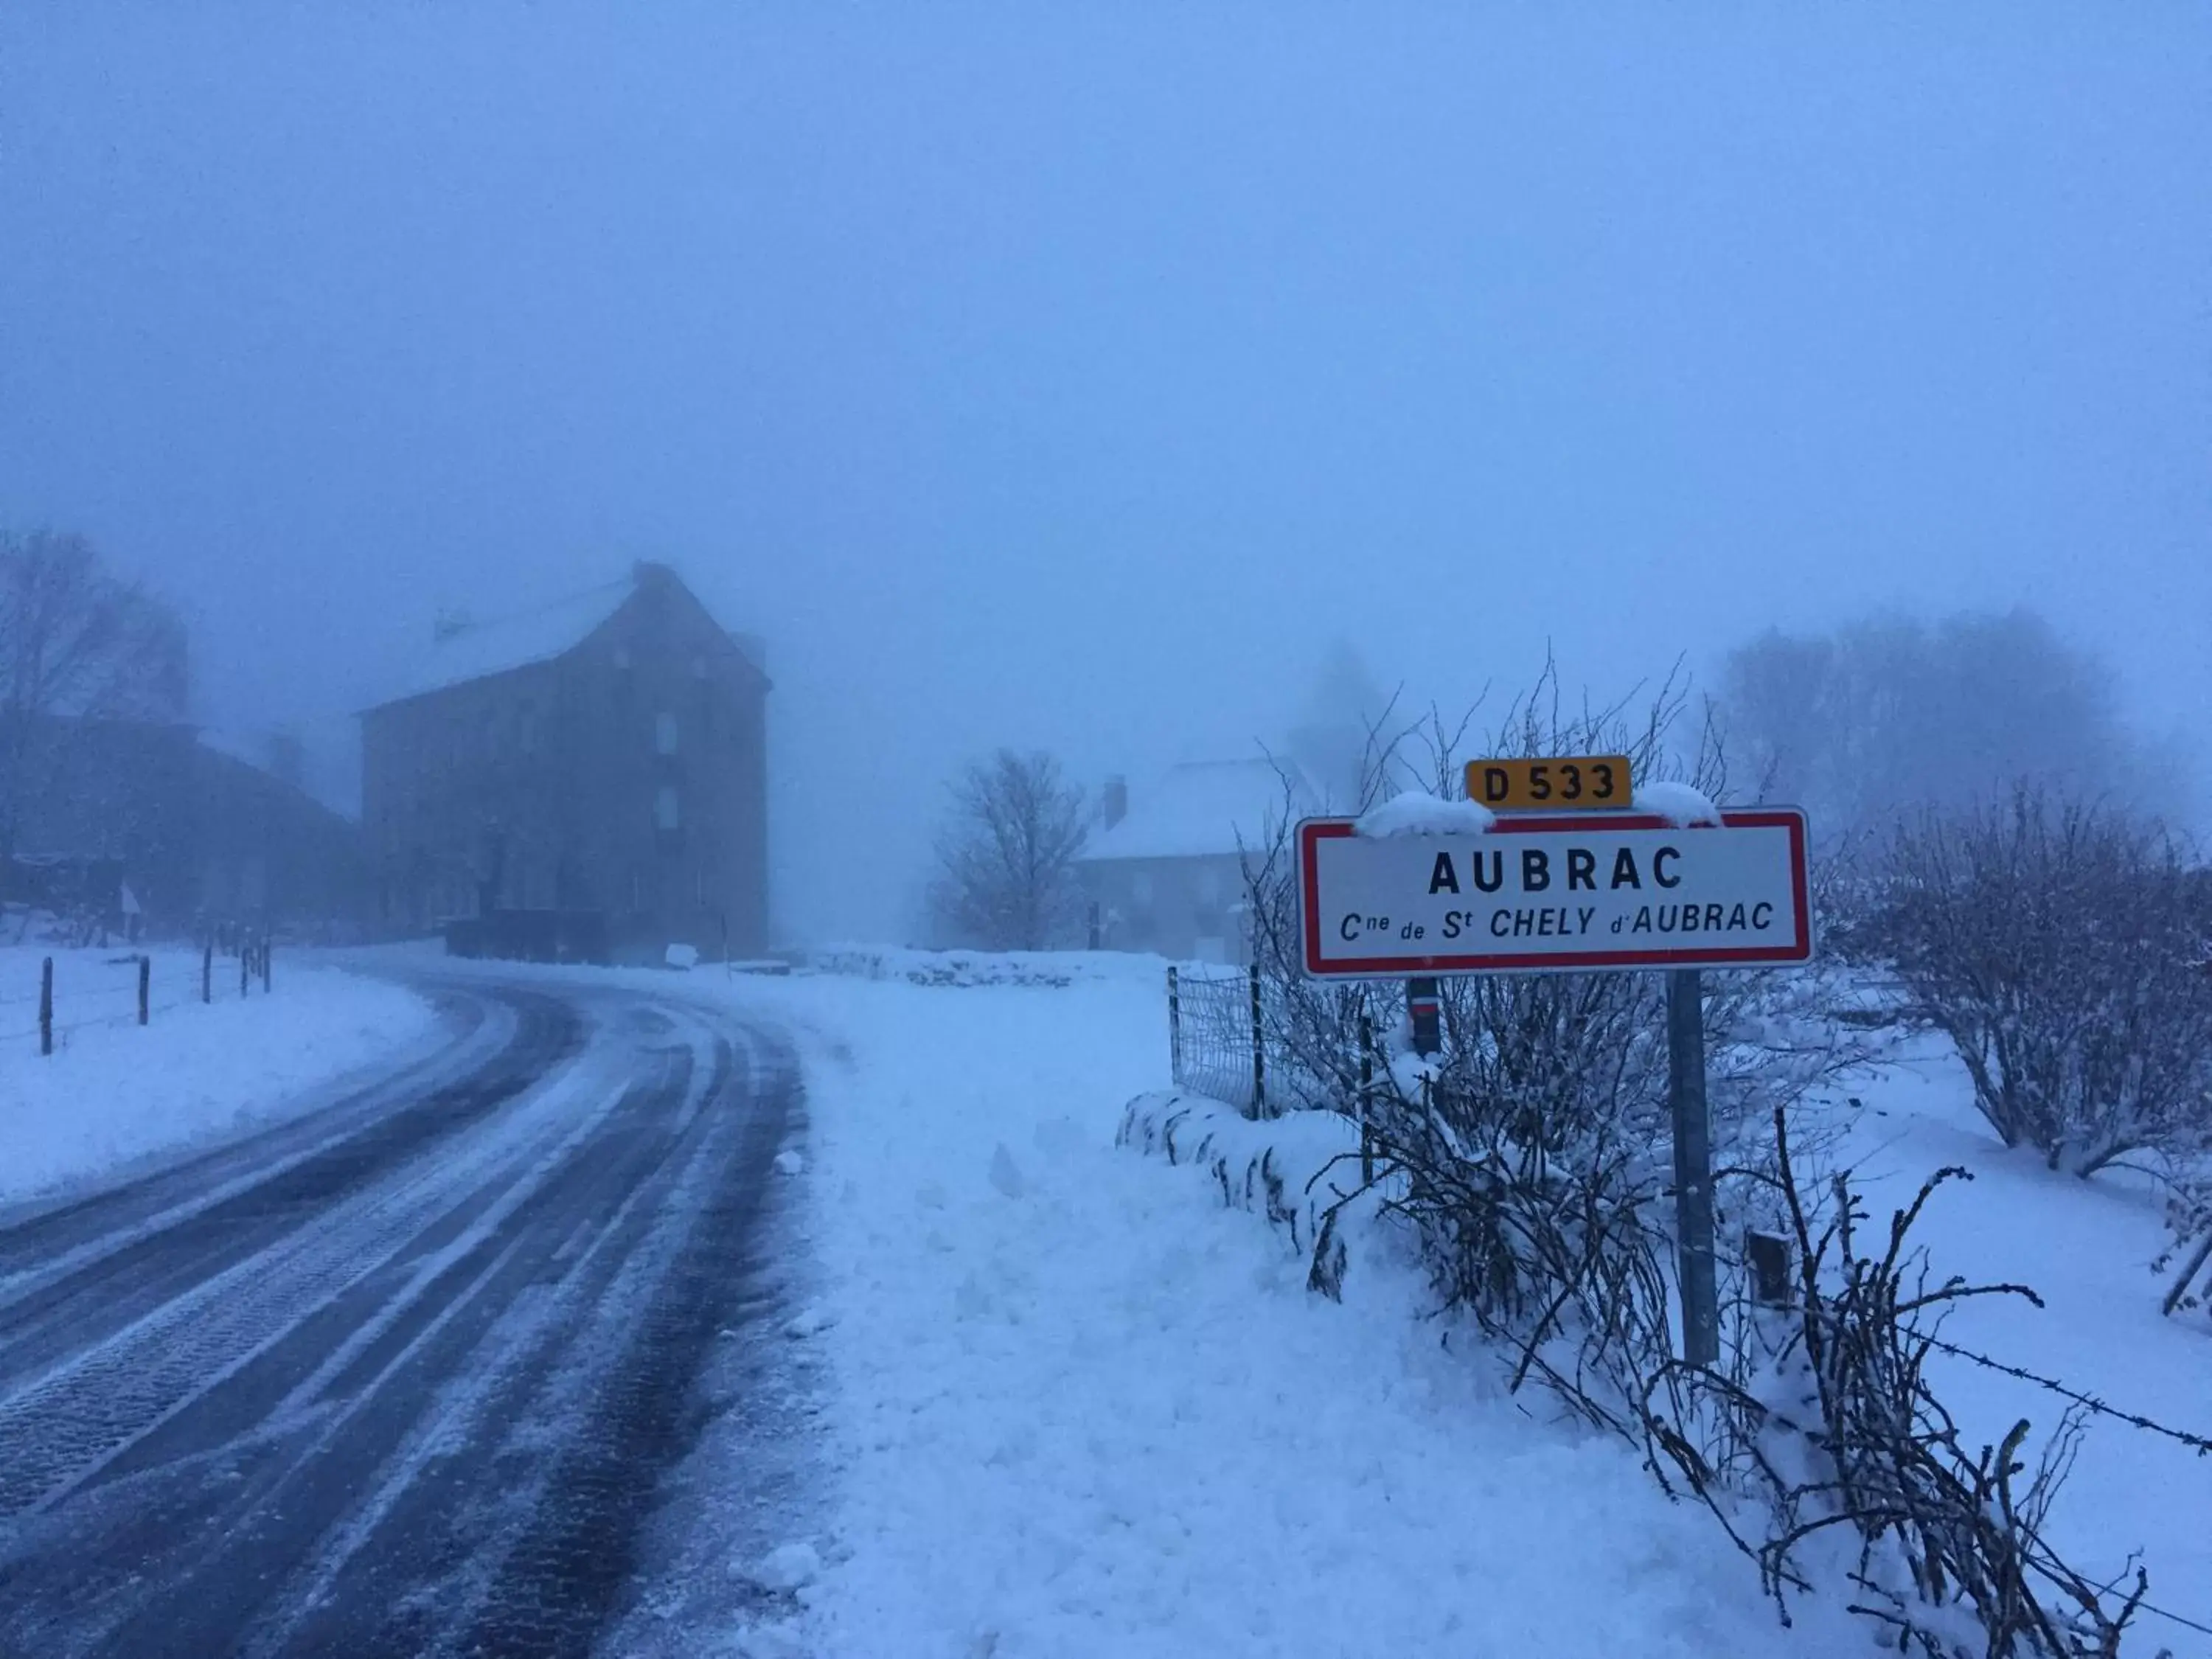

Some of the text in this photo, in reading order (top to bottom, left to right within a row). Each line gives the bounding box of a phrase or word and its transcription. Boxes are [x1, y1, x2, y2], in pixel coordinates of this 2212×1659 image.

[1484, 764, 1615, 802] D 533
[1428, 846, 1681, 894] AUBRAC
[1340, 902, 1773, 941] Cne de St CHELY d'AUBRAC
